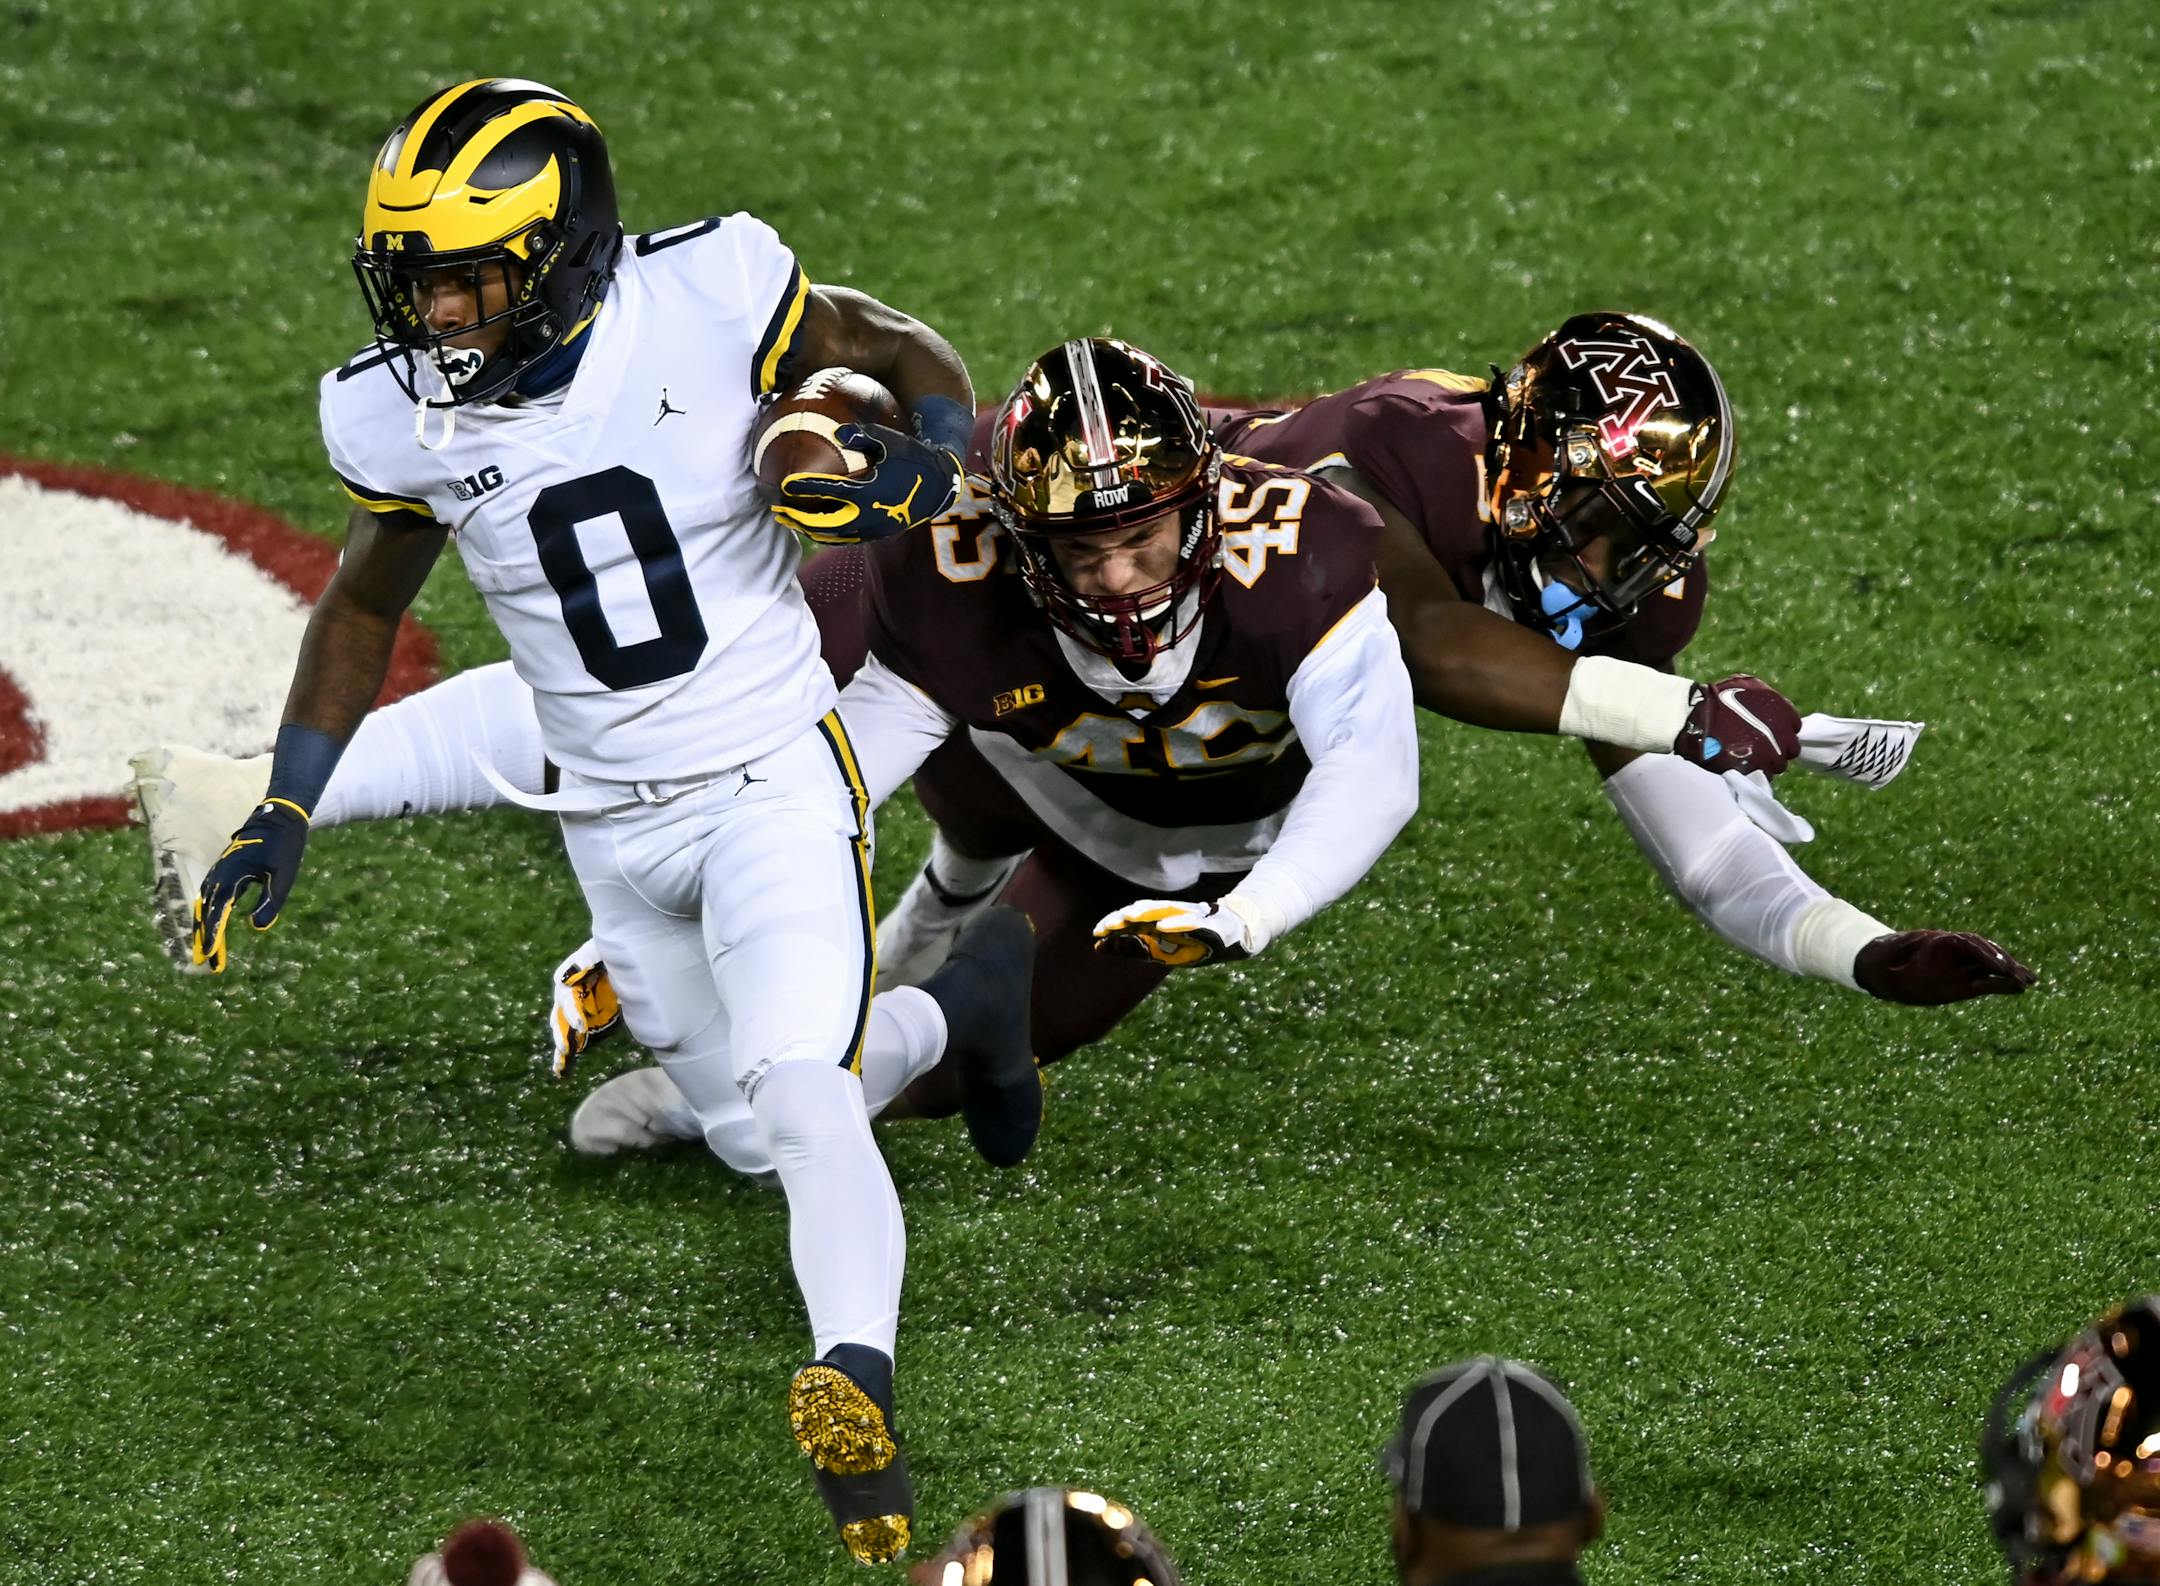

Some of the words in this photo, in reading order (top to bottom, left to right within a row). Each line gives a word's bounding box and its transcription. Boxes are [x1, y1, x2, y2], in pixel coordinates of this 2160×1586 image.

[385, 233, 405, 251] M
[1092, 483, 1130, 509] ROW
[1218, 476, 1312, 590] 45
[527, 465, 709, 691] 0
